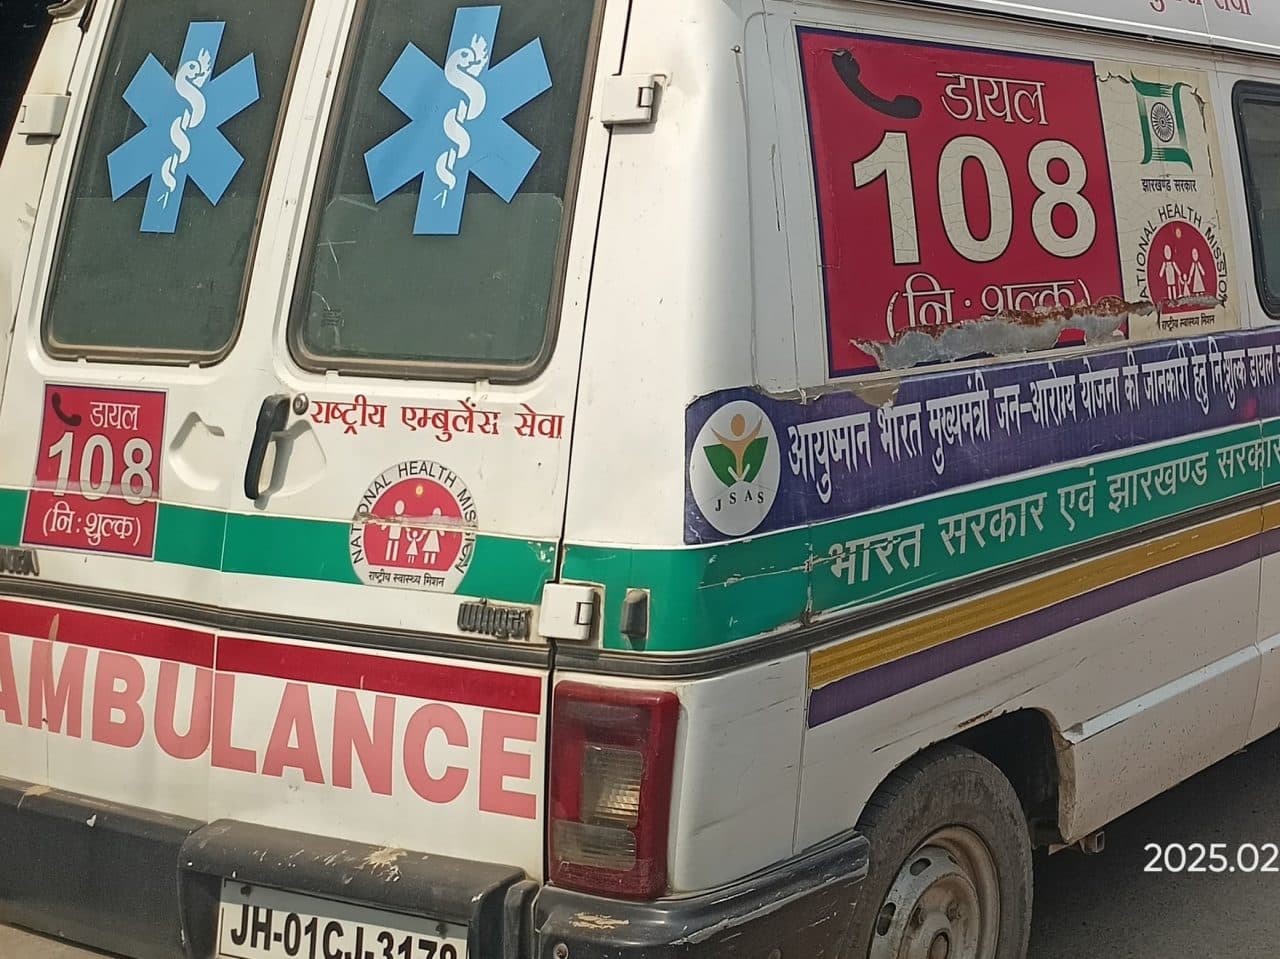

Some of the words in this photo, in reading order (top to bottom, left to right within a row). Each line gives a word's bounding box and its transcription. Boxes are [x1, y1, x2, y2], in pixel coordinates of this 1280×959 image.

[936, 71, 1050, 126] डायल
[852, 131, 1098, 266] 108
[1174, 178, 1197, 192] सरकार
[1136, 220, 1157, 306] ATIONAL
[1158, 203, 1201, 229] HEALTH
[90, 401, 141, 431] डायल
[311, 394, 388, 435] राष्ट्रीय
[400, 396, 501, 442] एम्बुलेंस
[514, 402, 566, 440] सेवा
[787, 412, 872, 504] आयुष्मान
[877, 401, 923, 463] भारत
[926, 369, 991, 475] मुख्यमंत्री
[1079, 356, 1121, 419] योजना
[1123, 348, 1140, 411] की
[1141, 340, 1190, 406] जानकारी
[1248, 345, 1274, 388] डायल
[48, 431, 153, 505] 108
[350, 474, 392, 564] NATONAL
[398, 460, 457, 488] HEALTH
[828, 523, 924, 585] भारत
[938, 492, 1048, 557] सरकार
[1057, 468, 1097, 531] एवं
[1107, 451, 1208, 514] झारखण्ड
